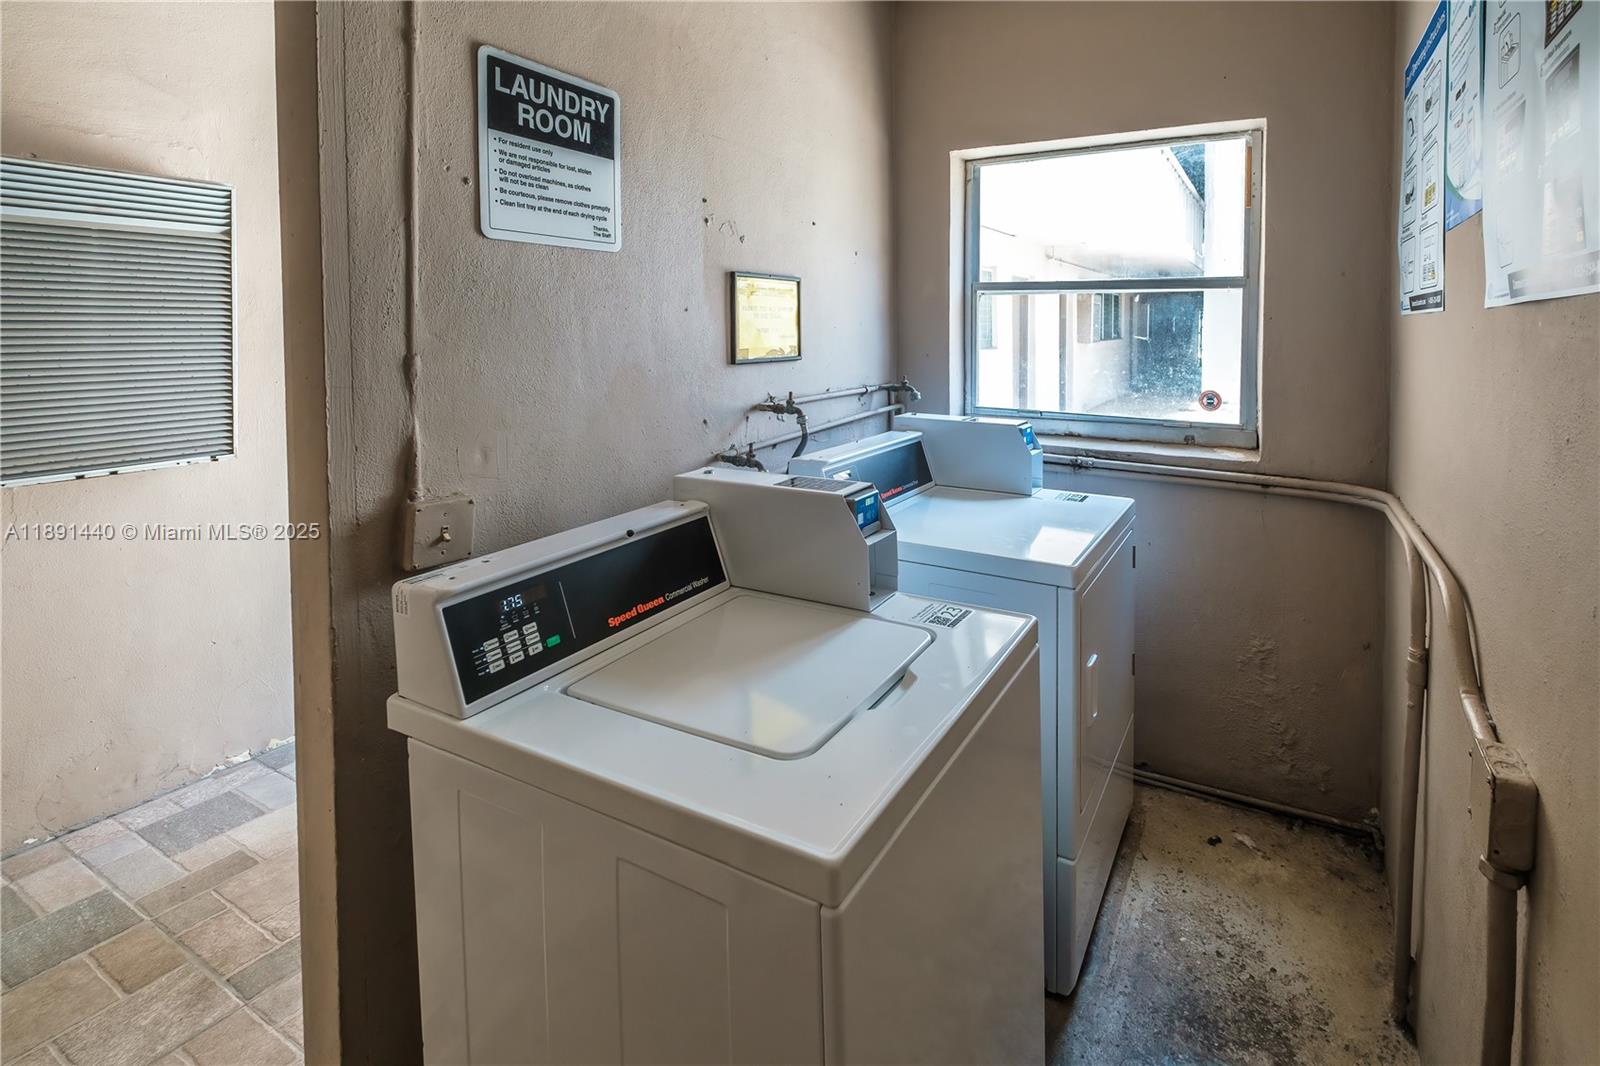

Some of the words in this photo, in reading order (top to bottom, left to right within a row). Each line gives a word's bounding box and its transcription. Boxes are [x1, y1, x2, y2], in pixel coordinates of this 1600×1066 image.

[495, 66, 609, 123] LAUNDRY
[518, 102, 591, 144] ROOM
[498, 137, 508, 145] For
[509, 141, 531, 150] resident
[542, 149, 553, 157] only
[505, 159, 531, 169] damaged
[531, 165, 551, 173] articles
[528, 157, 557, 168] responsible
[518, 174, 541, 182] overload
[542, 178, 567, 188] machines,
[574, 184, 592, 192] clothes
[499, 198, 516, 207] Clean
[526, 204, 537, 212] tray
[580, 213, 596, 221] drying
[508, 190, 537, 200] courteous,
[573, 200, 590, 209] clothes
[591, 204, 611, 213] promptly
[607, 606, 638, 627] Speed
[637, 595, 666, 614] Queen
[664, 583, 693, 601] Commercial
[691, 576, 710, 589] Washer
[940, 606, 964, 618] 23
